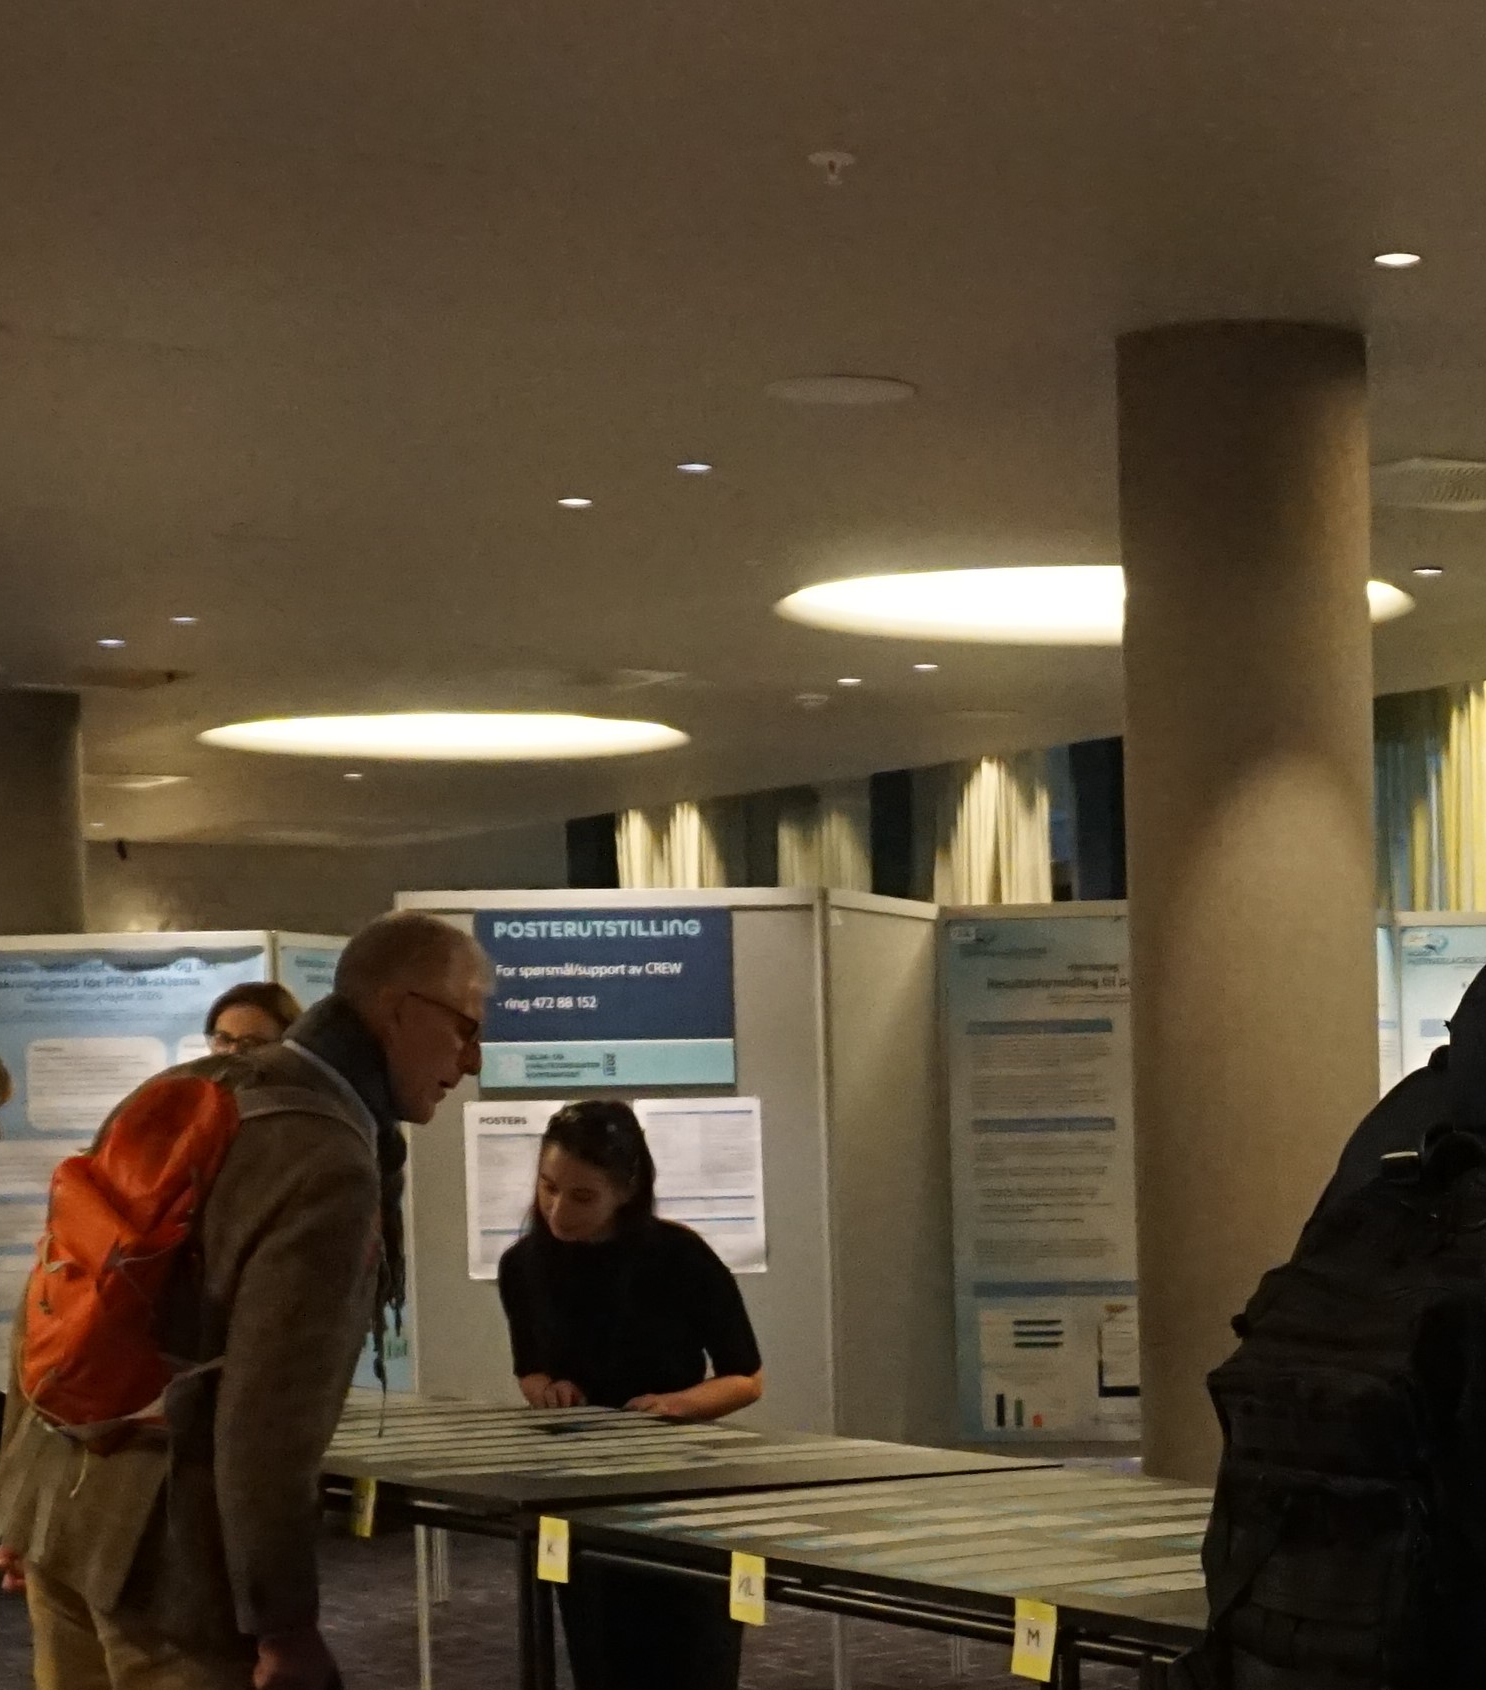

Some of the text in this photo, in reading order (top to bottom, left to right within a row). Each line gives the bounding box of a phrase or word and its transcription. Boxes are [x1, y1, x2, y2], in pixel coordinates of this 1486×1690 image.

[493, 918, 702, 938] POSTERUTSTILLING
[495, 962, 684, 978] For spørsmål/support av CREW
[504, 997, 531, 1012] ring
[532, 997, 554, 1009] 472
[577, 996, 598, 1009] 152
[479, 1116, 527, 1126] POSTERS
[546, 1542, 556, 1557] K
[1026, 1628, 1040, 1648] M
